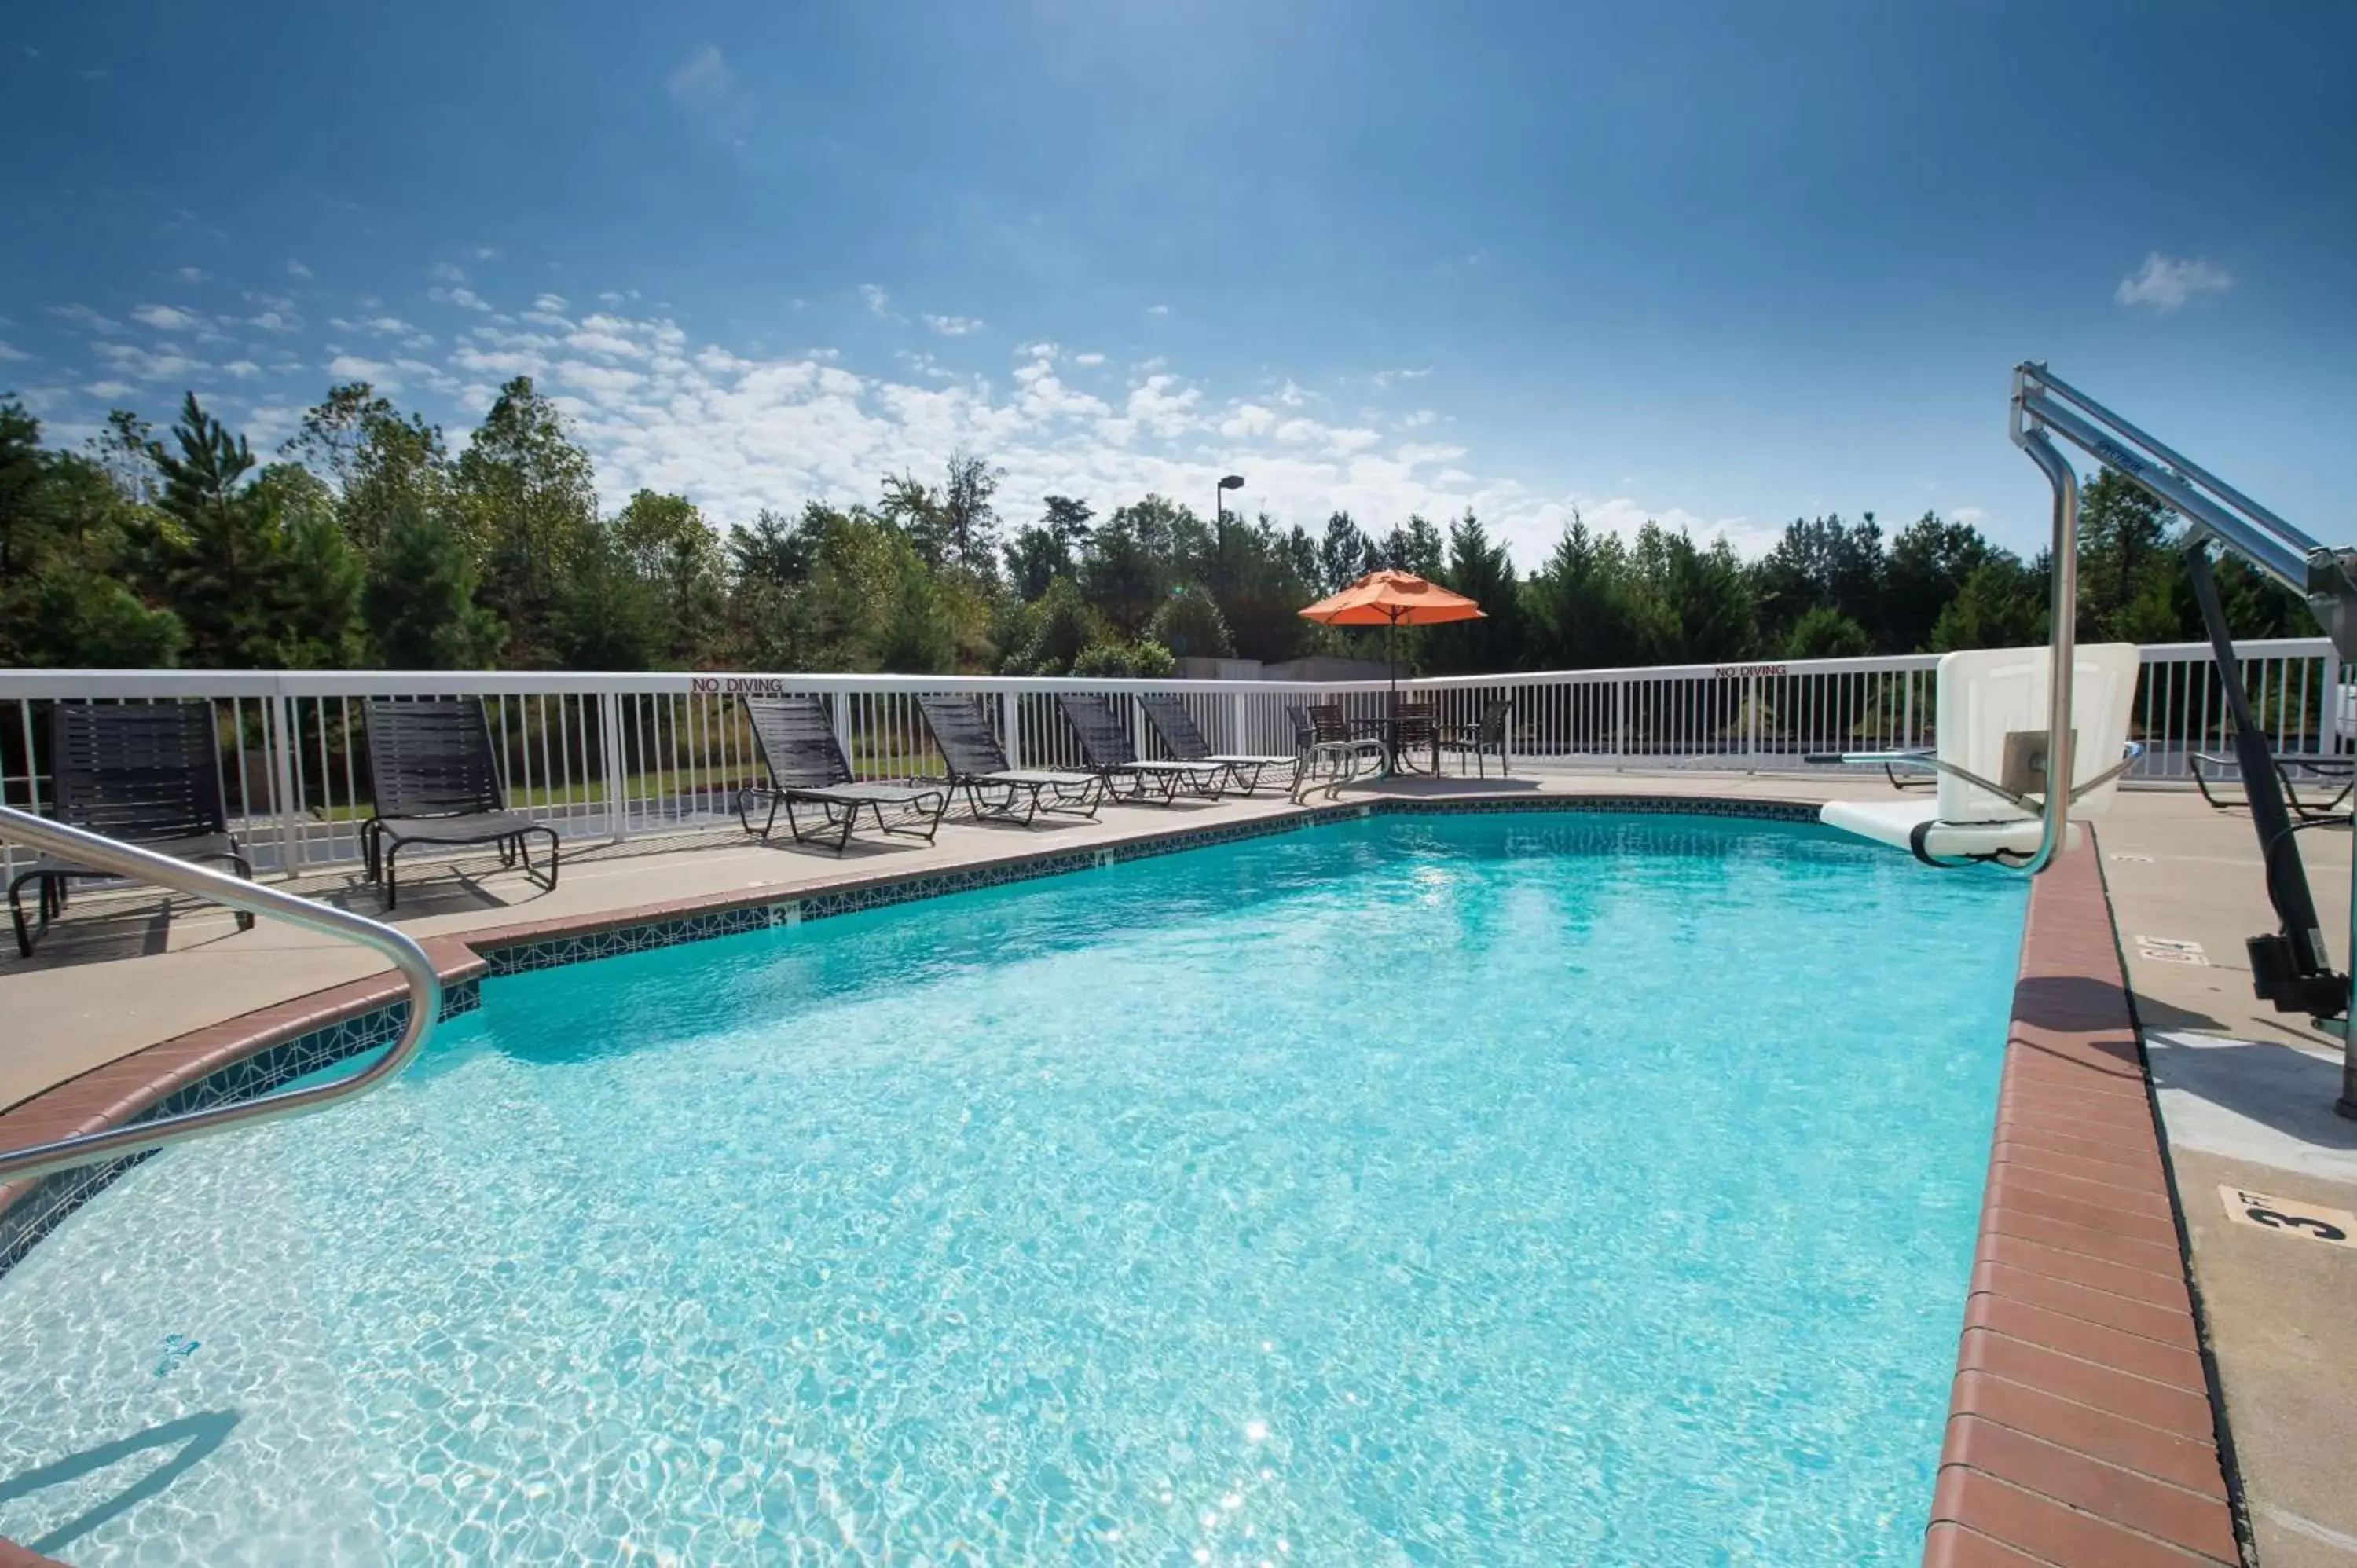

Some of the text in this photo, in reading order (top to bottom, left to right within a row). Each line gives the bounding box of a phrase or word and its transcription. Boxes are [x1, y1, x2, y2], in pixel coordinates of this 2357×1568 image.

[1715, 665, 1786, 677] NO DIVING
[692, 678, 783, 692] NO DIVING
[773, 907, 787, 926] 3
[2246, 1207, 2346, 1240] 3
